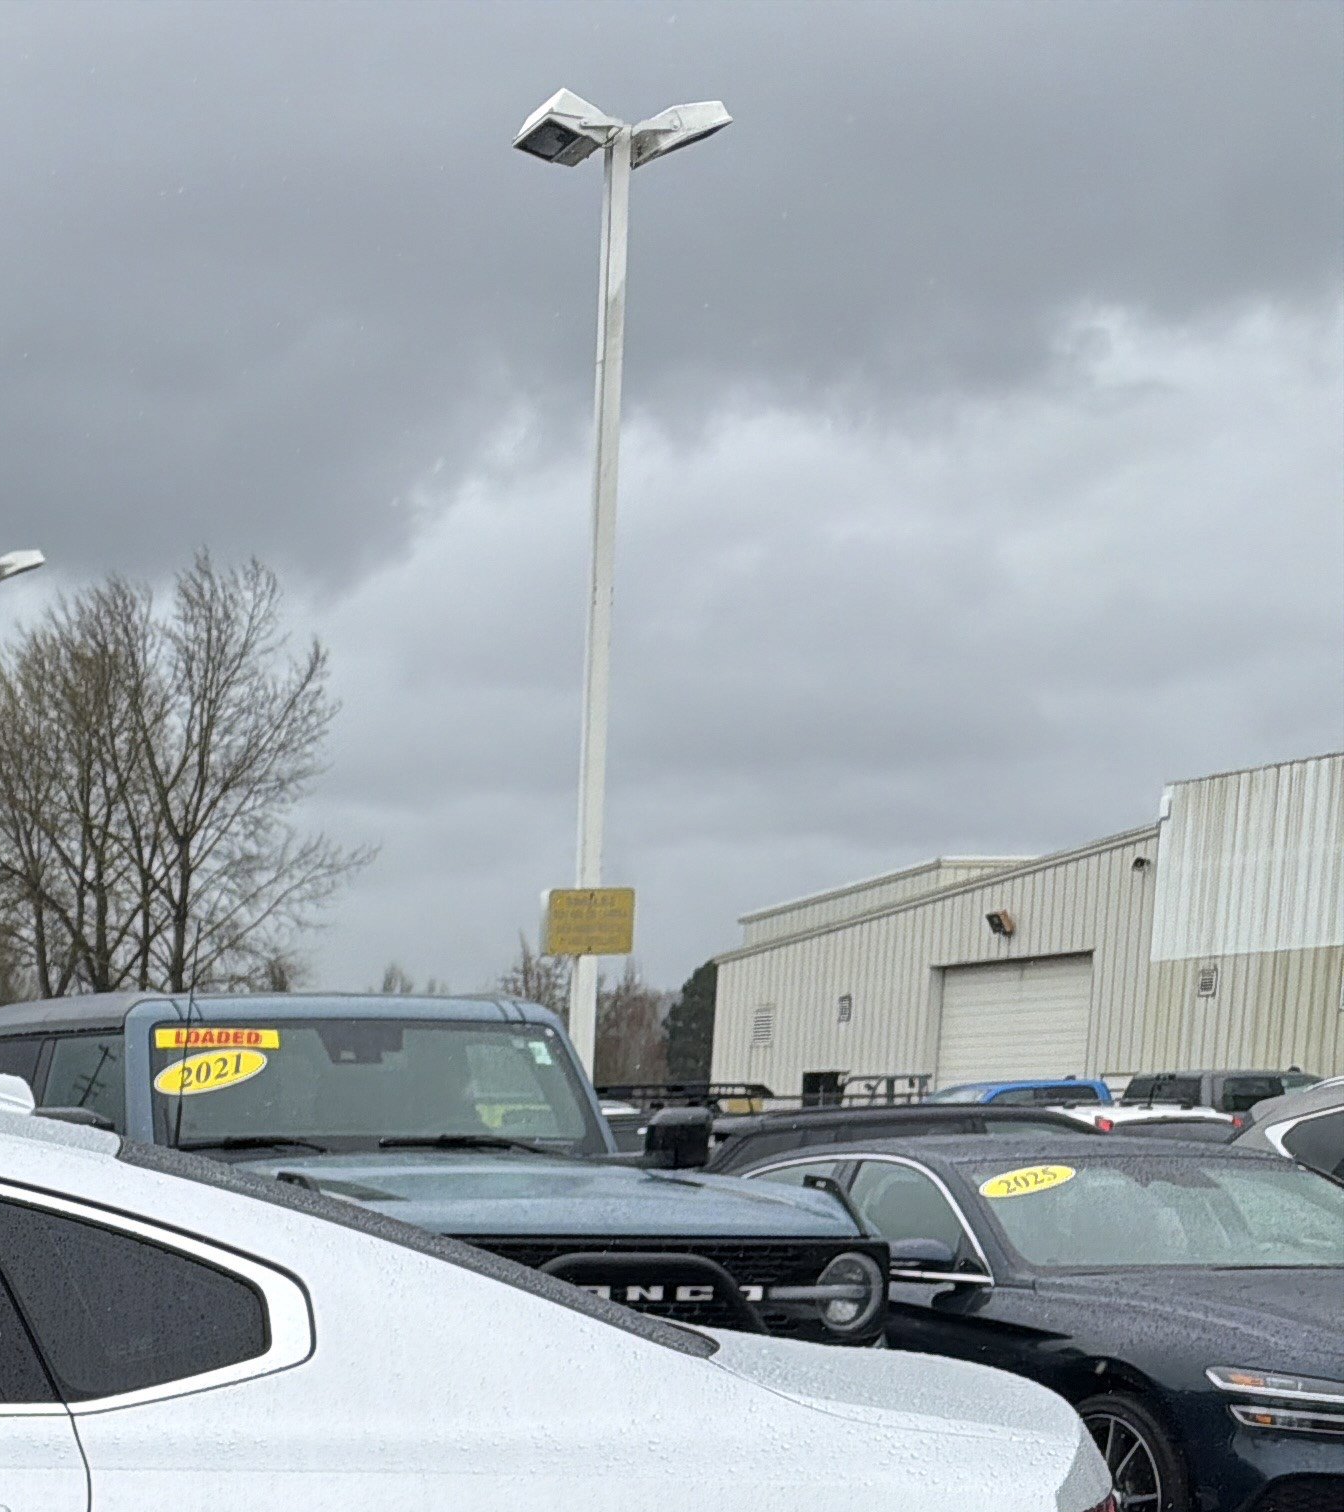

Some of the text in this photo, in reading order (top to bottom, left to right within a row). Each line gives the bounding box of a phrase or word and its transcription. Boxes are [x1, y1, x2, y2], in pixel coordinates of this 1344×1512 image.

[175, 1031, 262, 1045] LOADED
[179, 1053, 242, 1089] 2021
[998, 1168, 1058, 1194] 2025
